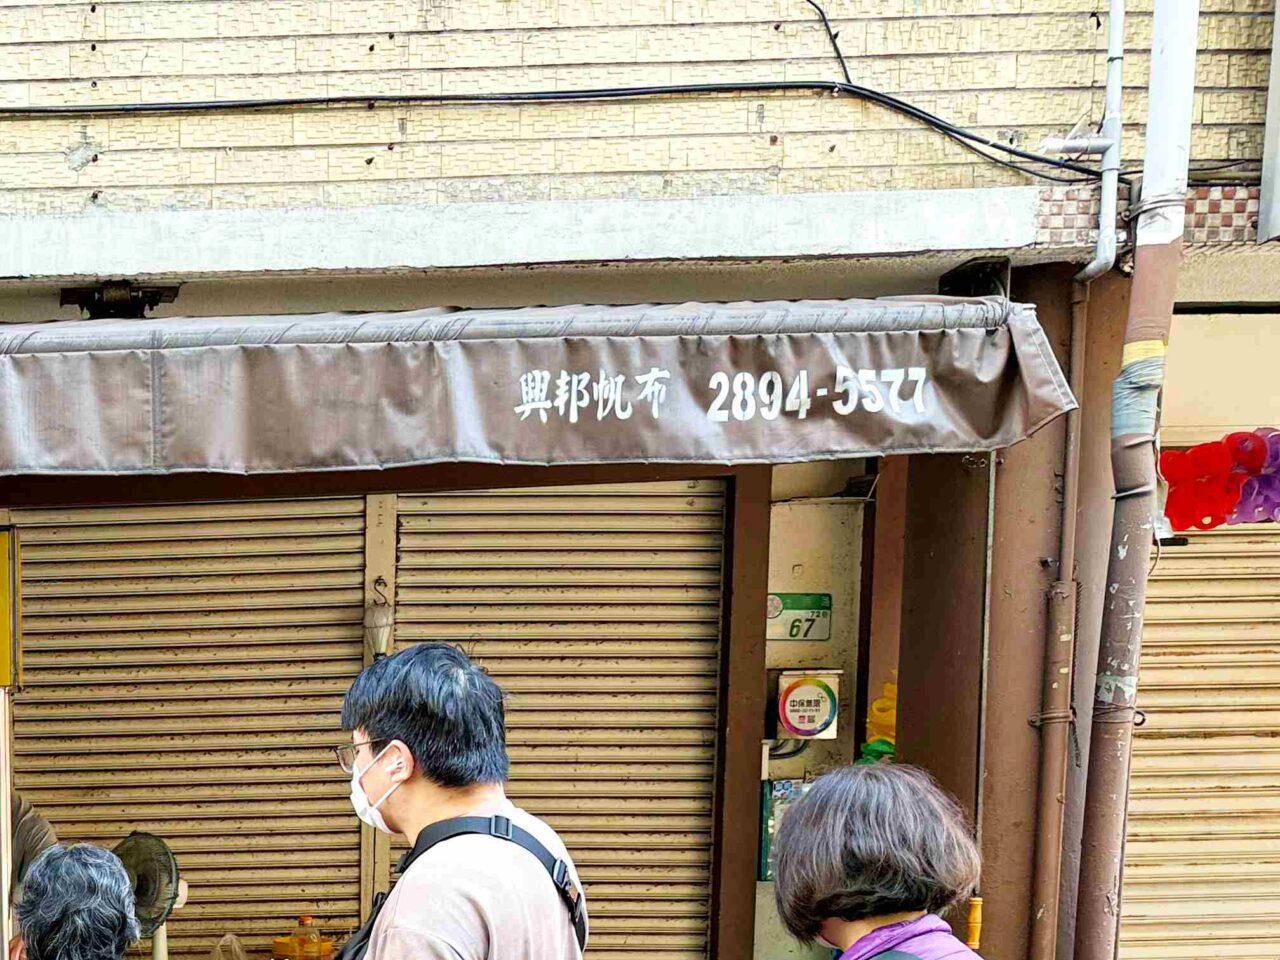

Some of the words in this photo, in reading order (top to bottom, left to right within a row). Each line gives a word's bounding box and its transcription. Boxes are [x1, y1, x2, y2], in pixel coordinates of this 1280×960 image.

[514, 366, 671, 424] 興邦帆布
[707, 366, 927, 422] 2894-5577
[789, 618, 817, 638] 67
